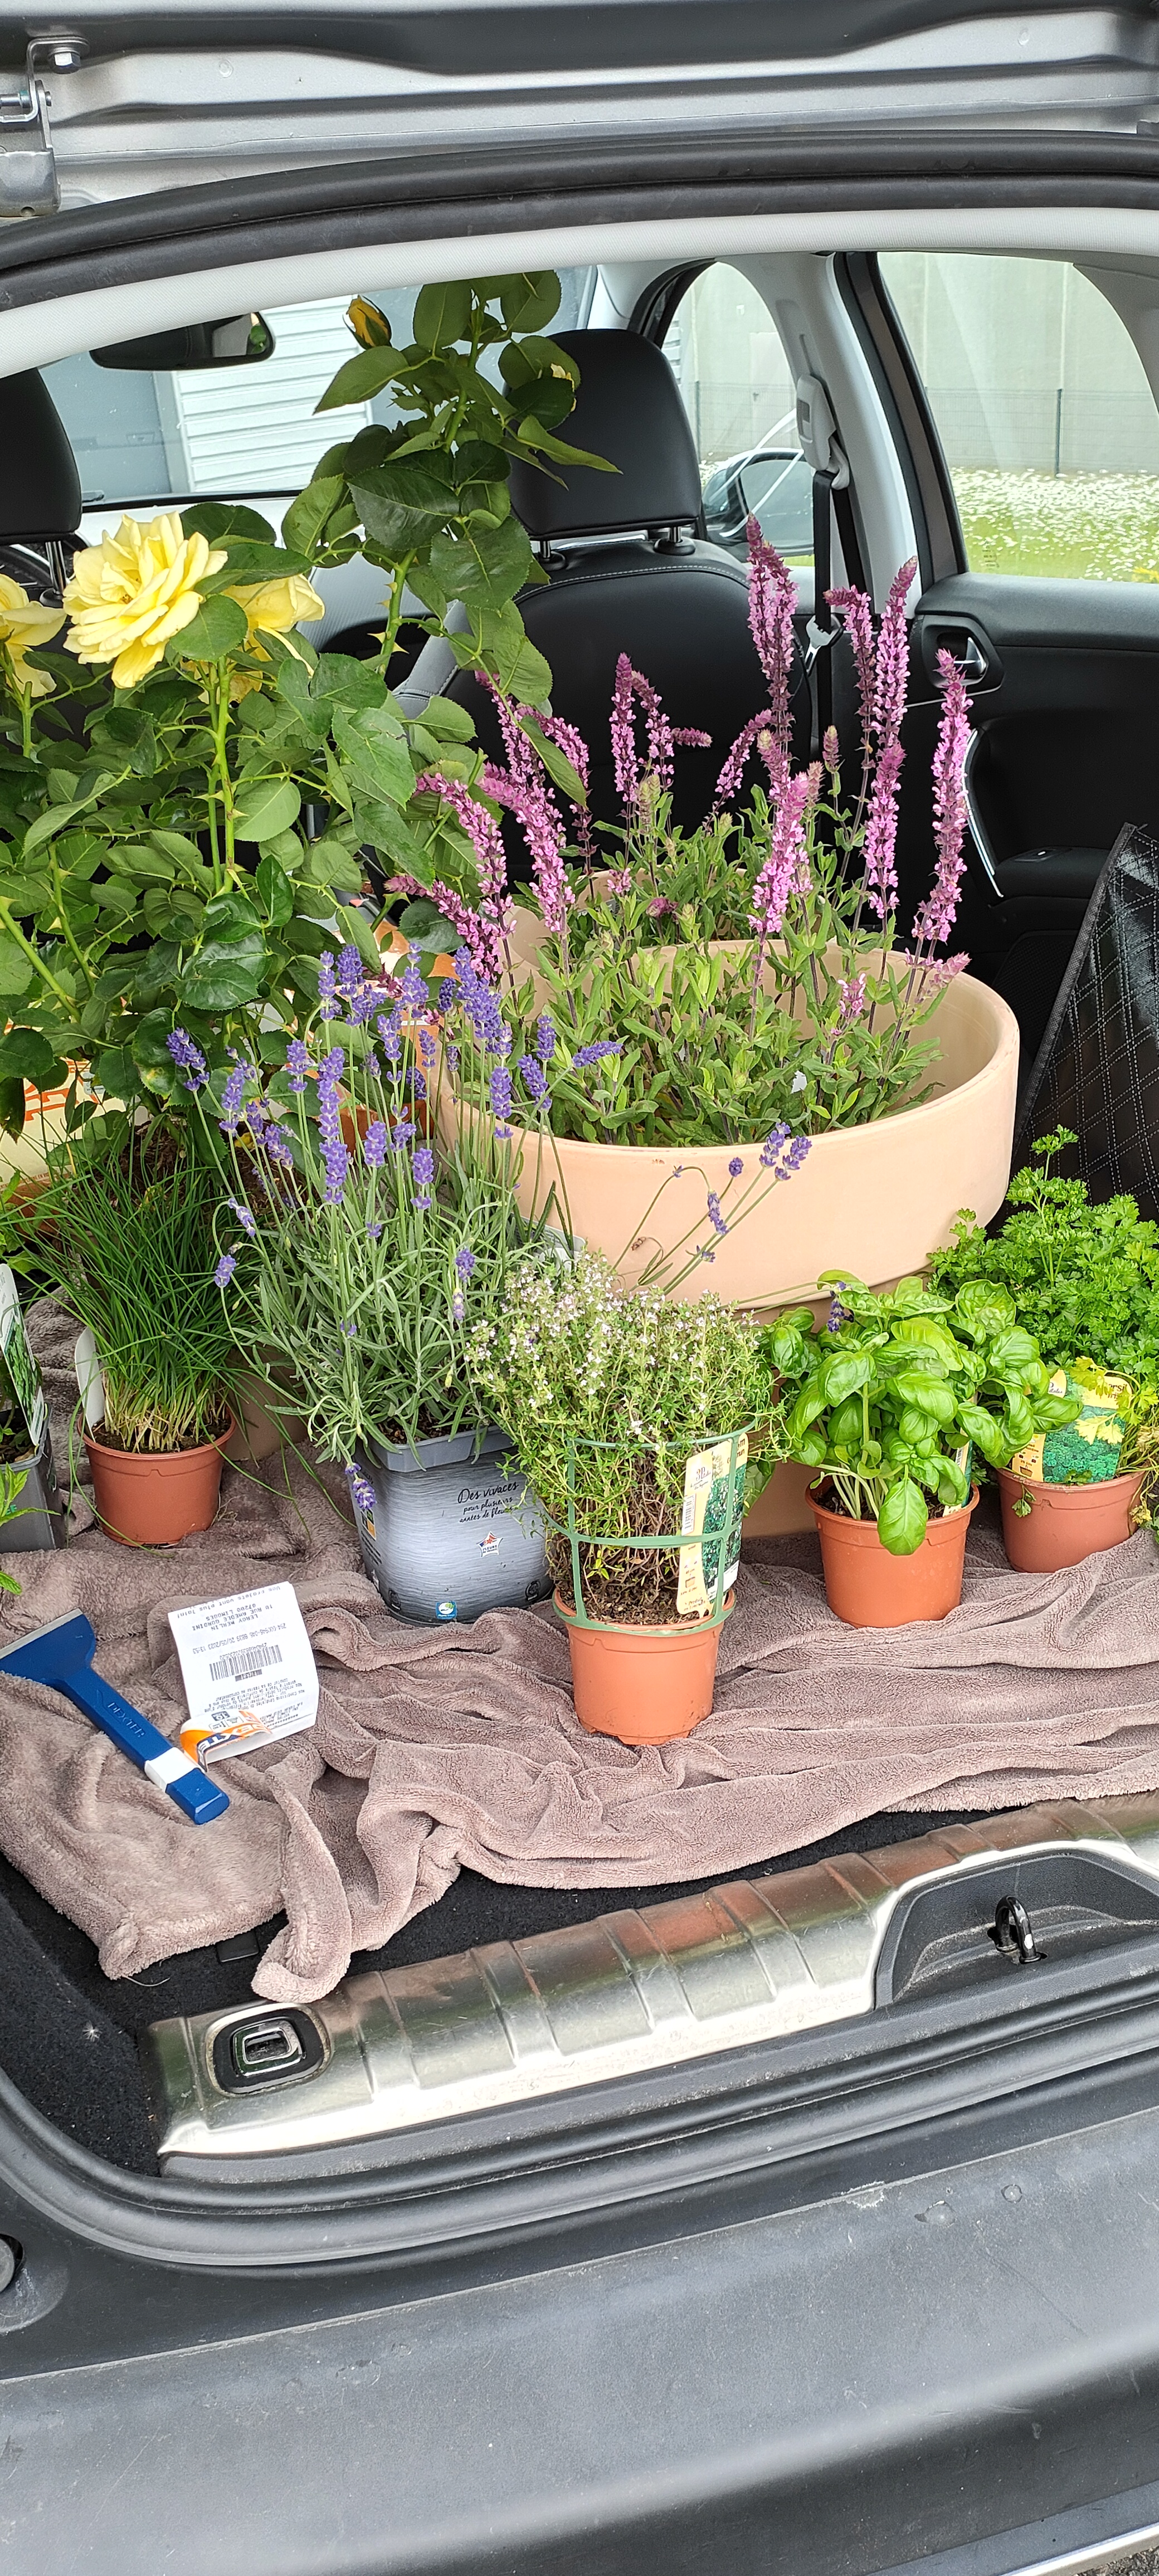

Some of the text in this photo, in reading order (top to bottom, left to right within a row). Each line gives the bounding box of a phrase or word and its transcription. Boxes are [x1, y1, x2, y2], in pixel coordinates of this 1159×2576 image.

[457, 1481, 519, 1504] Des vivaces
[463, 1497, 513, 1515] pour plusieurs
[460, 1513, 481, 1523] années
[483, 1510, 489, 1518] de
[238, 1590, 265, 1600] projets
[199, 1603, 215, 1612] plus
[206, 1609, 233, 1621] LIMOGES
[192, 1619, 220, 1631] GORDINI
[211, 1613, 259, 1631] LEROY MERLIN
[208, 1637, 236, 1650] 20/05/2023
[108, 1702, 146, 1738] DEXTER
